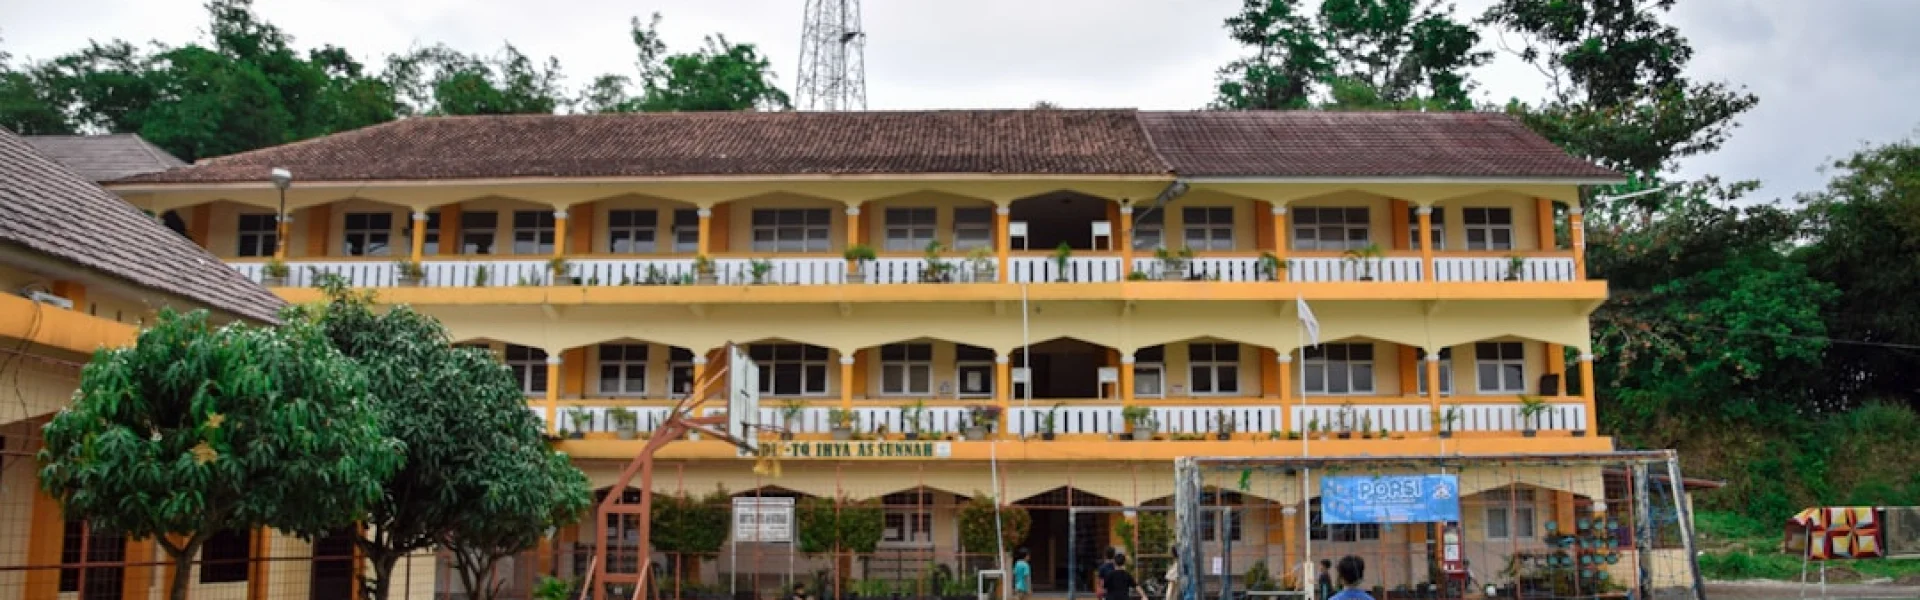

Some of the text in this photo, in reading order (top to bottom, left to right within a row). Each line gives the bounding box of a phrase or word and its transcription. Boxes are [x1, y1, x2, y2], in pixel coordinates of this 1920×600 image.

[815, 443, 851, 457] IHYA
[857, 443, 874, 457] AS
[878, 443, 932, 457] SUNNAH
